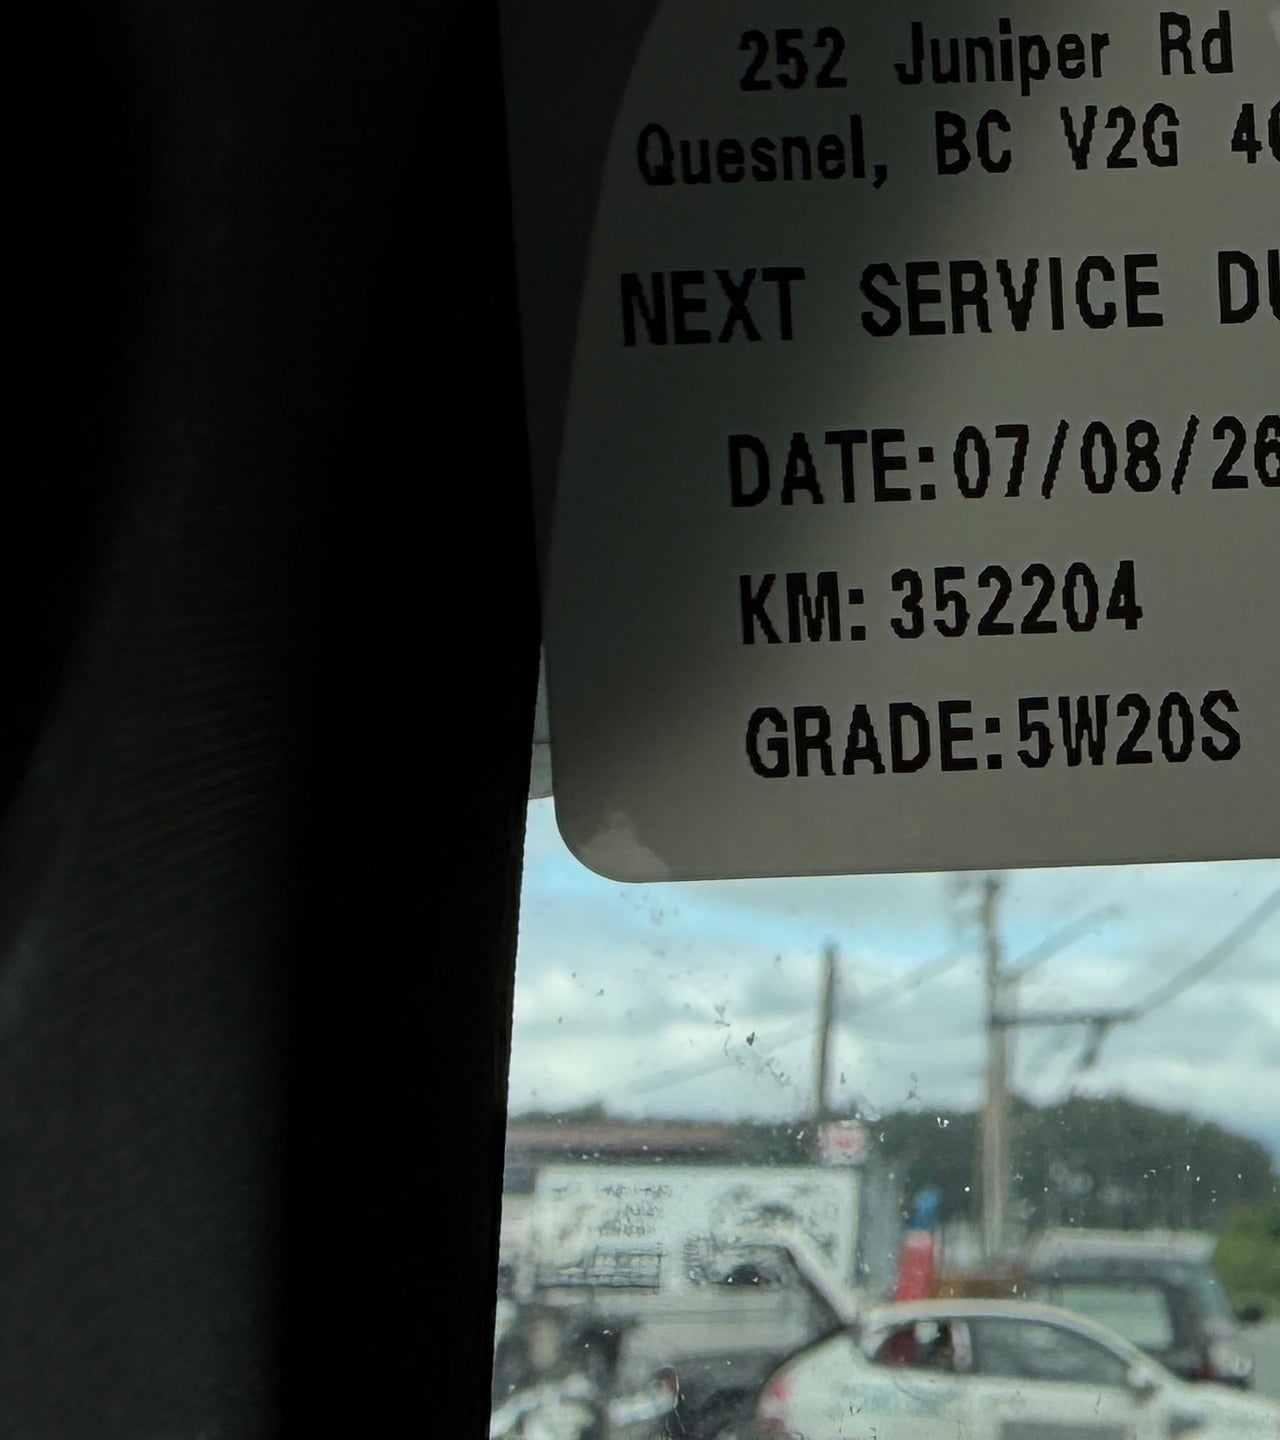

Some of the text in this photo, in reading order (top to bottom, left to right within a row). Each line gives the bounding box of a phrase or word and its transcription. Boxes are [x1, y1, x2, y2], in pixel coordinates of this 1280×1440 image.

[738, 10, 1233, 96] 252 Juniper Rd
[636, 114, 887, 189] Quesnel,
[935, 109, 1011, 175] BC
[1060, 103, 1179, 170] V2G
[620, 267, 805, 347] NEXT
[859, 254, 1163, 337] SERVICE
